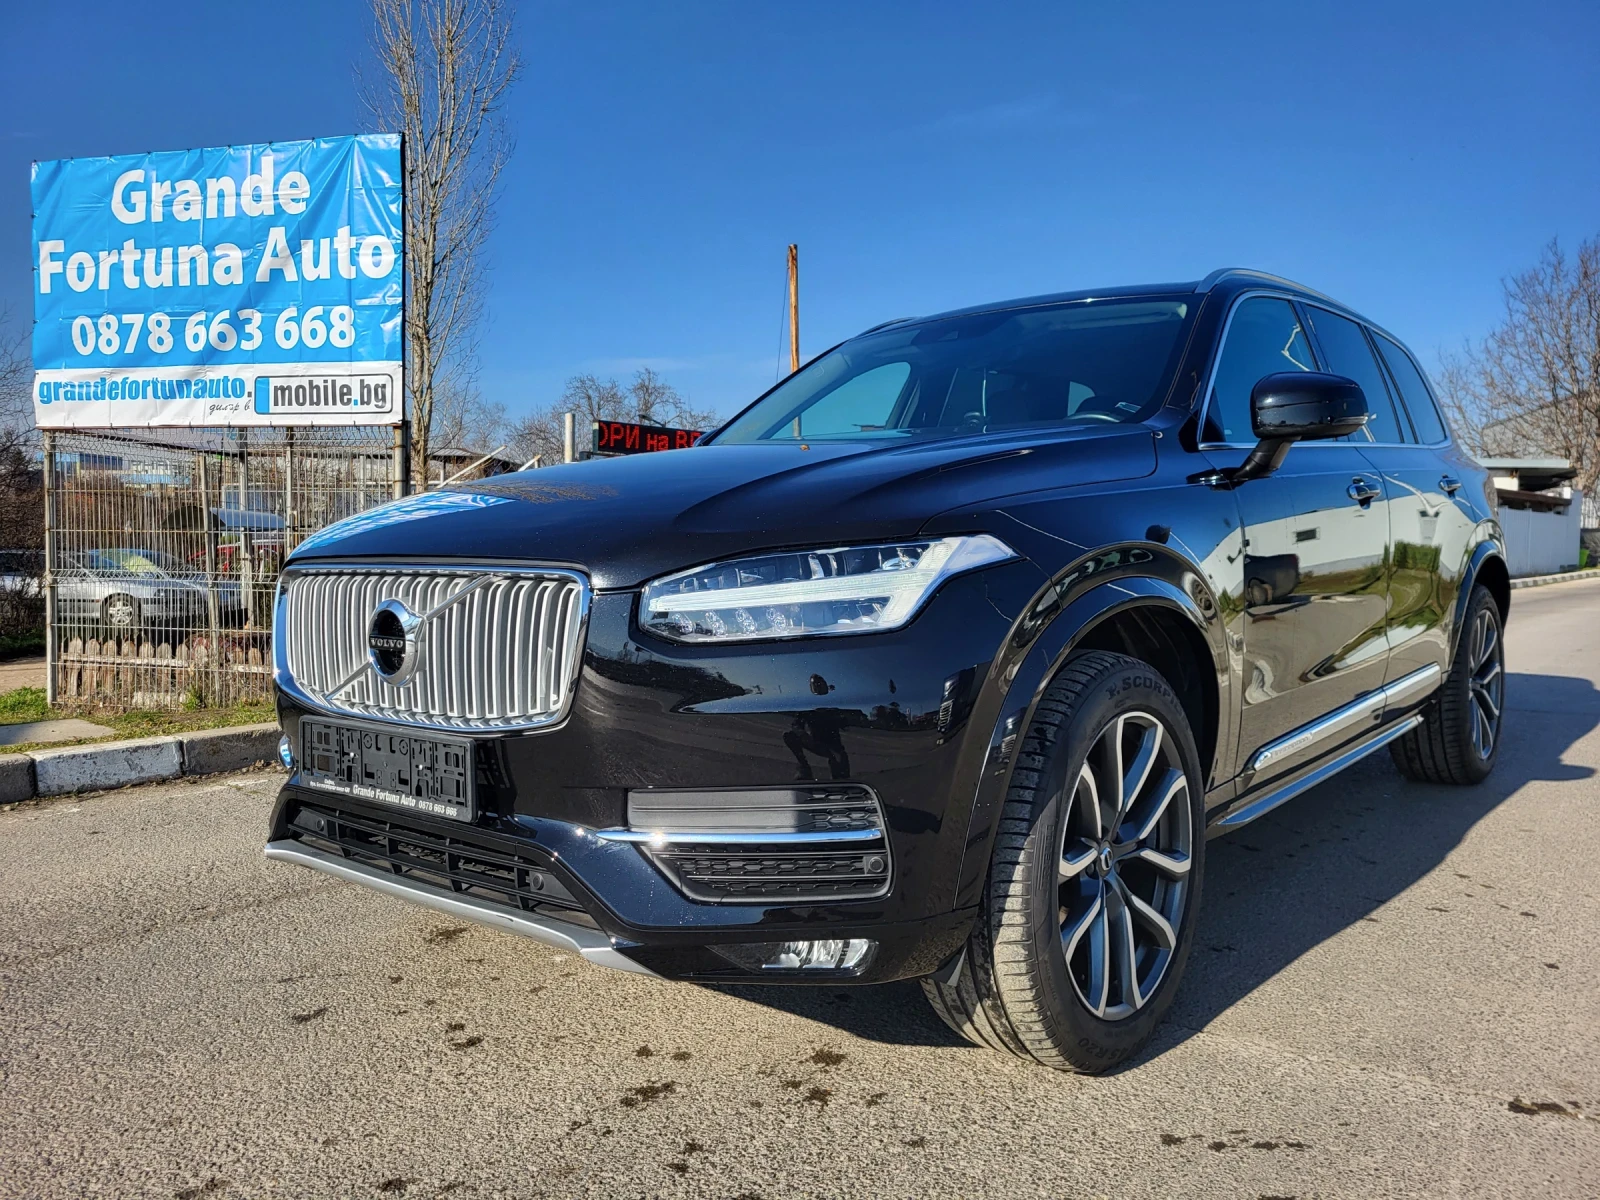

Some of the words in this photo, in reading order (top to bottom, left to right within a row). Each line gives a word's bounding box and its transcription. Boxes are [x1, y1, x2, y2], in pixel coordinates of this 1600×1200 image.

[110, 155, 311, 225] Grande
[38, 238, 244, 294] Fortuna
[255, 224, 396, 283] Auto
[71, 311, 174, 356] 0878
[184, 309, 264, 352] 663
[274, 305, 356, 349] 668
[272, 378, 388, 410] mobile.bg
[370, 637, 404, 648] VOLVO
[352, 784, 375, 798] Grande
[375, 788, 400, 804] Fortuna
[400, 793, 417, 807] Auto
